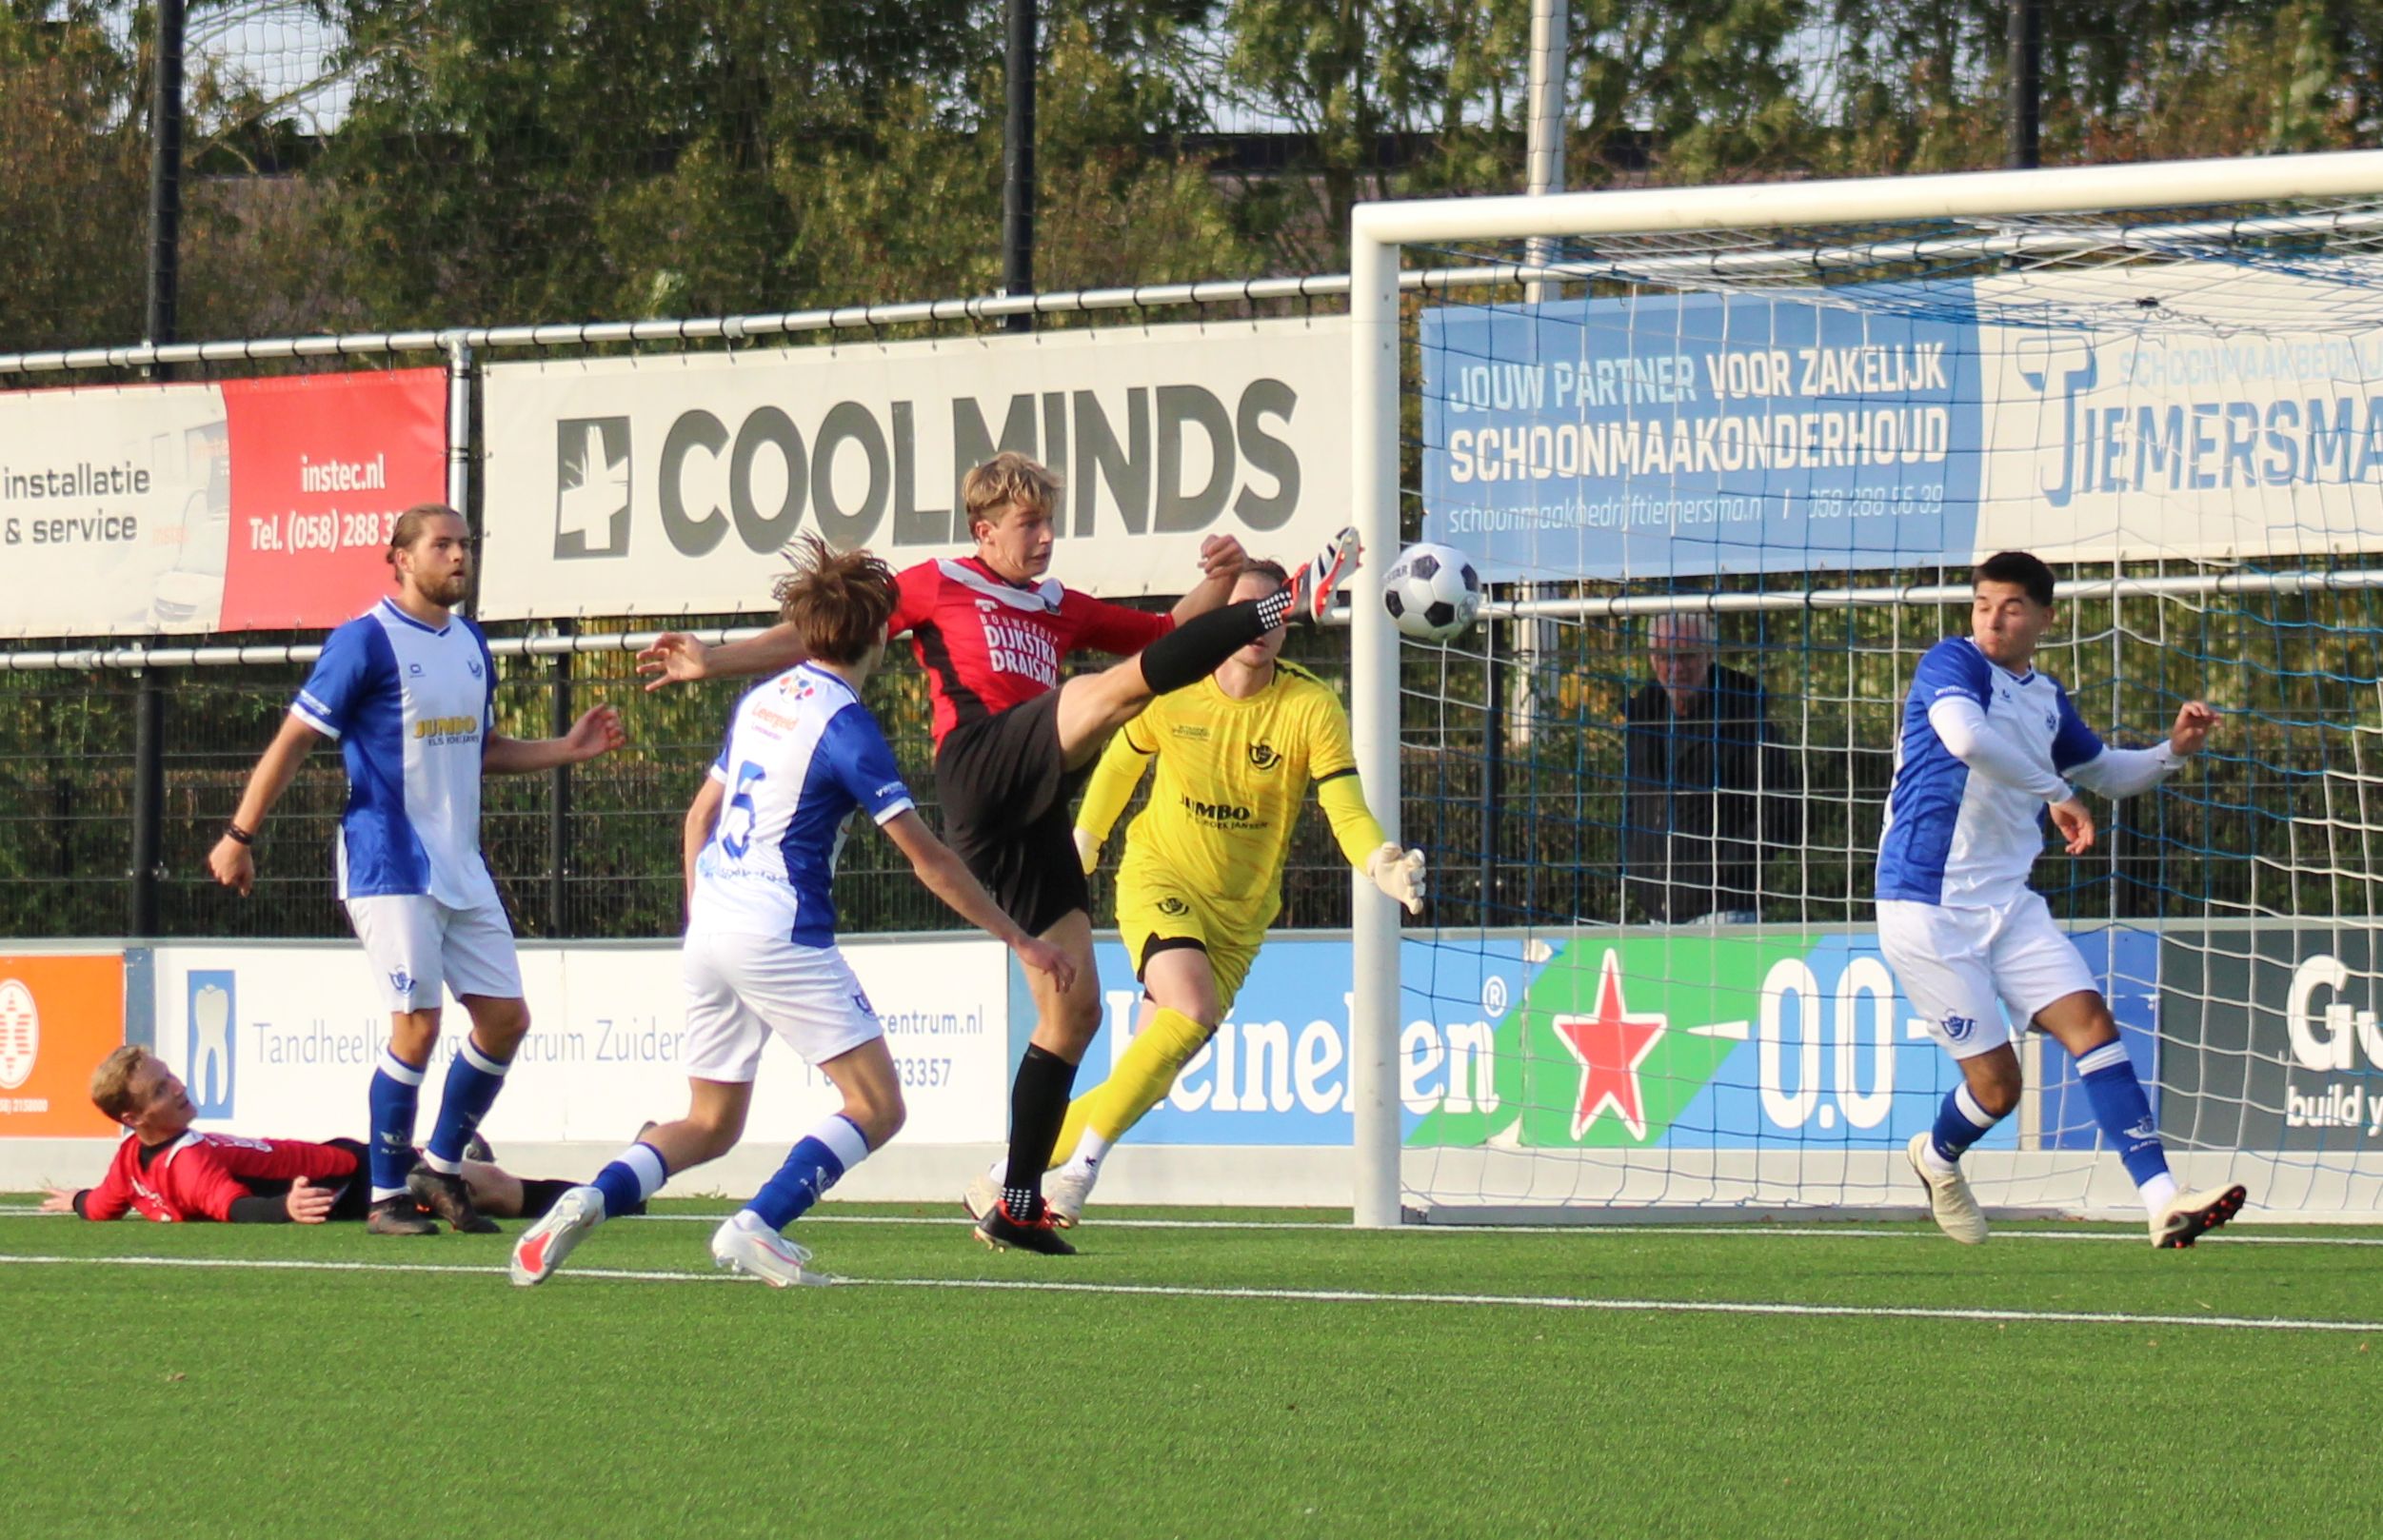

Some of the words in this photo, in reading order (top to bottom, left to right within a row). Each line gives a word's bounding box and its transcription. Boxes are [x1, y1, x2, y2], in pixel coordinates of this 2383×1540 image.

[1449, 364, 1544, 413] JOUW
[1554, 355, 1697, 408] PARTNER
[1706, 350, 1793, 400] VOOR
[1800, 343, 1947, 395] ZAKELIJK
[2118, 339, 2383, 388] SCHOONMAAKBEDRIJ
[659, 378, 1301, 558] COOLMINDS
[1449, 407, 1949, 484] SCHOONMAAKONDERHOUD
[4, 462, 150, 500] installatie
[301, 453, 386, 493] instec.nl
[5, 517, 21, 545] &
[31, 509, 138, 543] service
[249, 514, 283, 551] Tel.
[288, 507, 340, 555] (058)
[343, 512, 380, 547] 288
[983, 624, 1058, 669] DIJKSTRA
[414, 716, 477, 739] JUMBO
[252, 1021, 461, 1064] Tandheelkig
[595, 1018, 685, 1062] Zuider
[1105, 990, 1500, 1116] eineen
[1759, 957, 1896, 1130] 0.0
[2287, 1083, 2365, 1128] build
